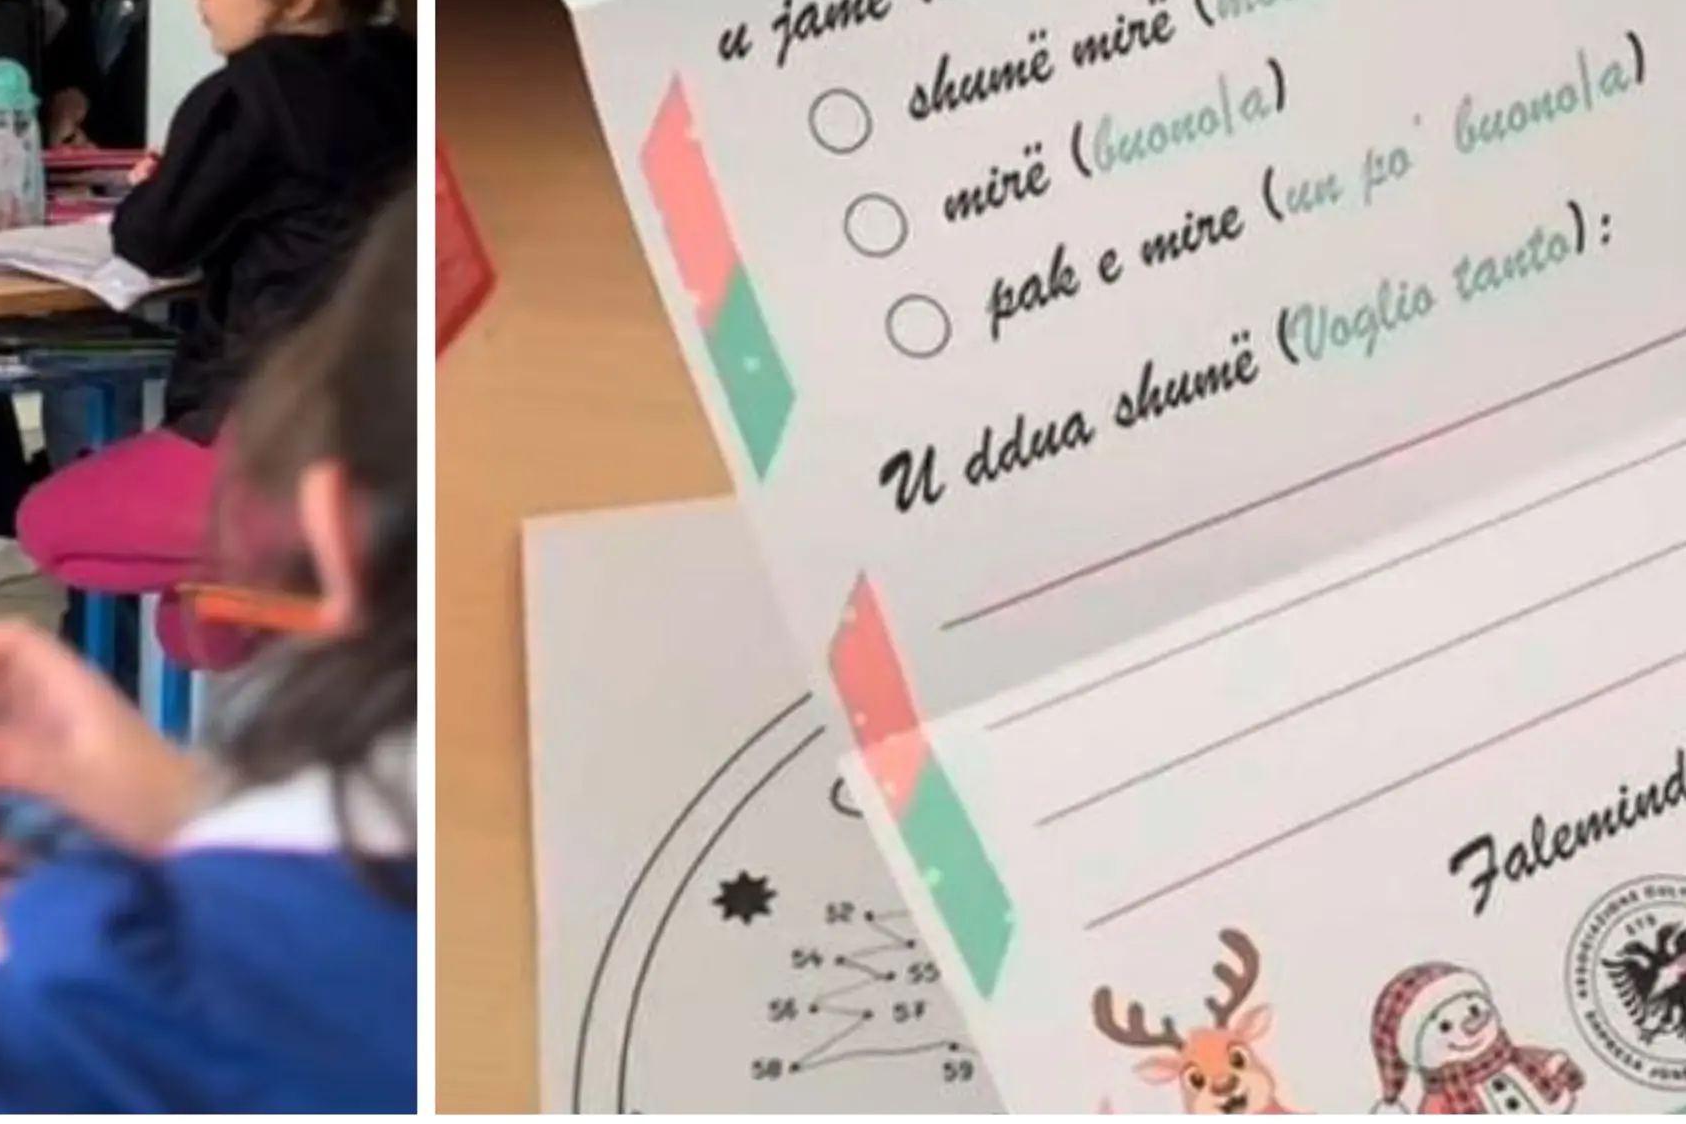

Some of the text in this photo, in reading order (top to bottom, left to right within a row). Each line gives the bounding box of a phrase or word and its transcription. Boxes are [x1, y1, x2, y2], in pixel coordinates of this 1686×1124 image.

[718, 26, 753, 62] u
[908, 28, 1055, 122] shumë
[943, 141, 1053, 223] mirë
[985, 242, 1082, 342] pak
[1098, 246, 1124, 285] e
[1140, 204, 1245, 267] mire
[1262, 166, 1345, 222] (un
[878, 200, 1613, 514] U ddua shumë (Voglio tanto):
[825, 901, 855, 924] 52
[791, 947, 824, 969] 54
[907, 962, 941, 985] 55
[893, 1000, 928, 1023] 57
[942, 1060, 975, 1083] 59
